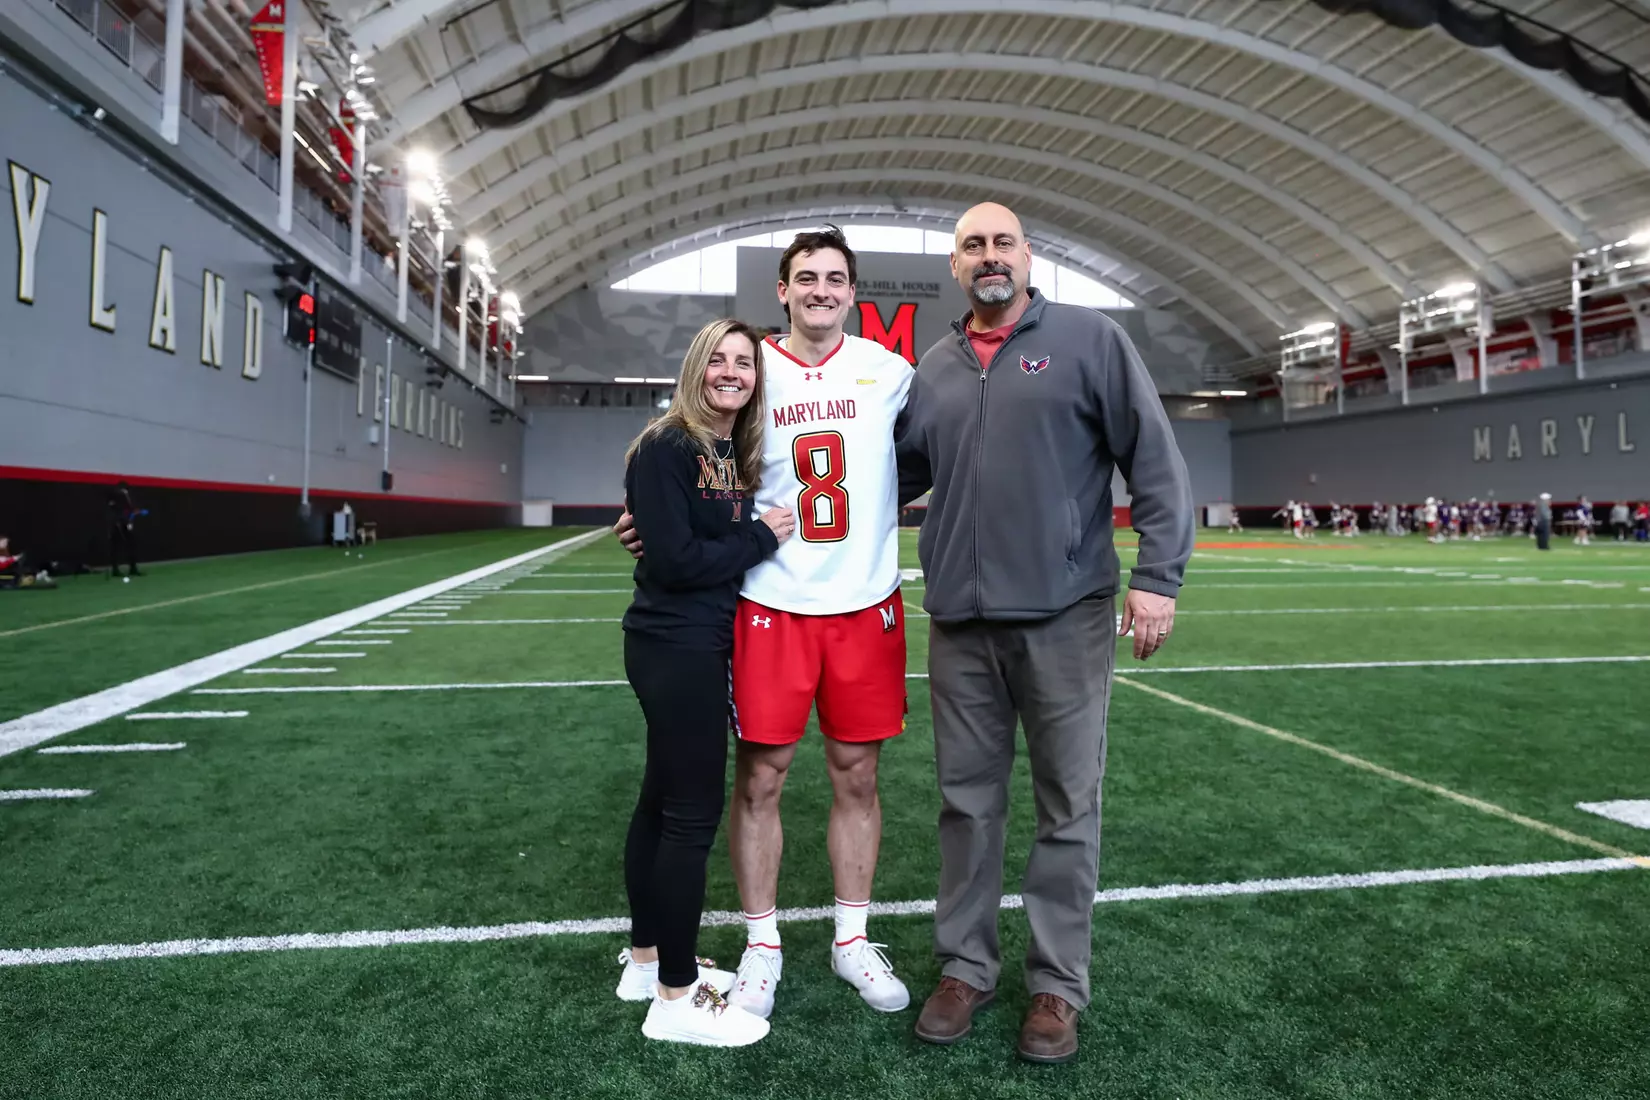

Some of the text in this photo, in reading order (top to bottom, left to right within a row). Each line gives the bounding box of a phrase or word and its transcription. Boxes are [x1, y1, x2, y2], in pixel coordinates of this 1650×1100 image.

[8, 159, 263, 381] YLAND
[902, 281, 941, 292] HOUSE
[857, 302, 918, 366] M
[773, 399, 856, 428] MARYLAND
[1473, 411, 1636, 462] MARYL
[792, 430, 850, 543] 8
[878, 604, 896, 630] M
